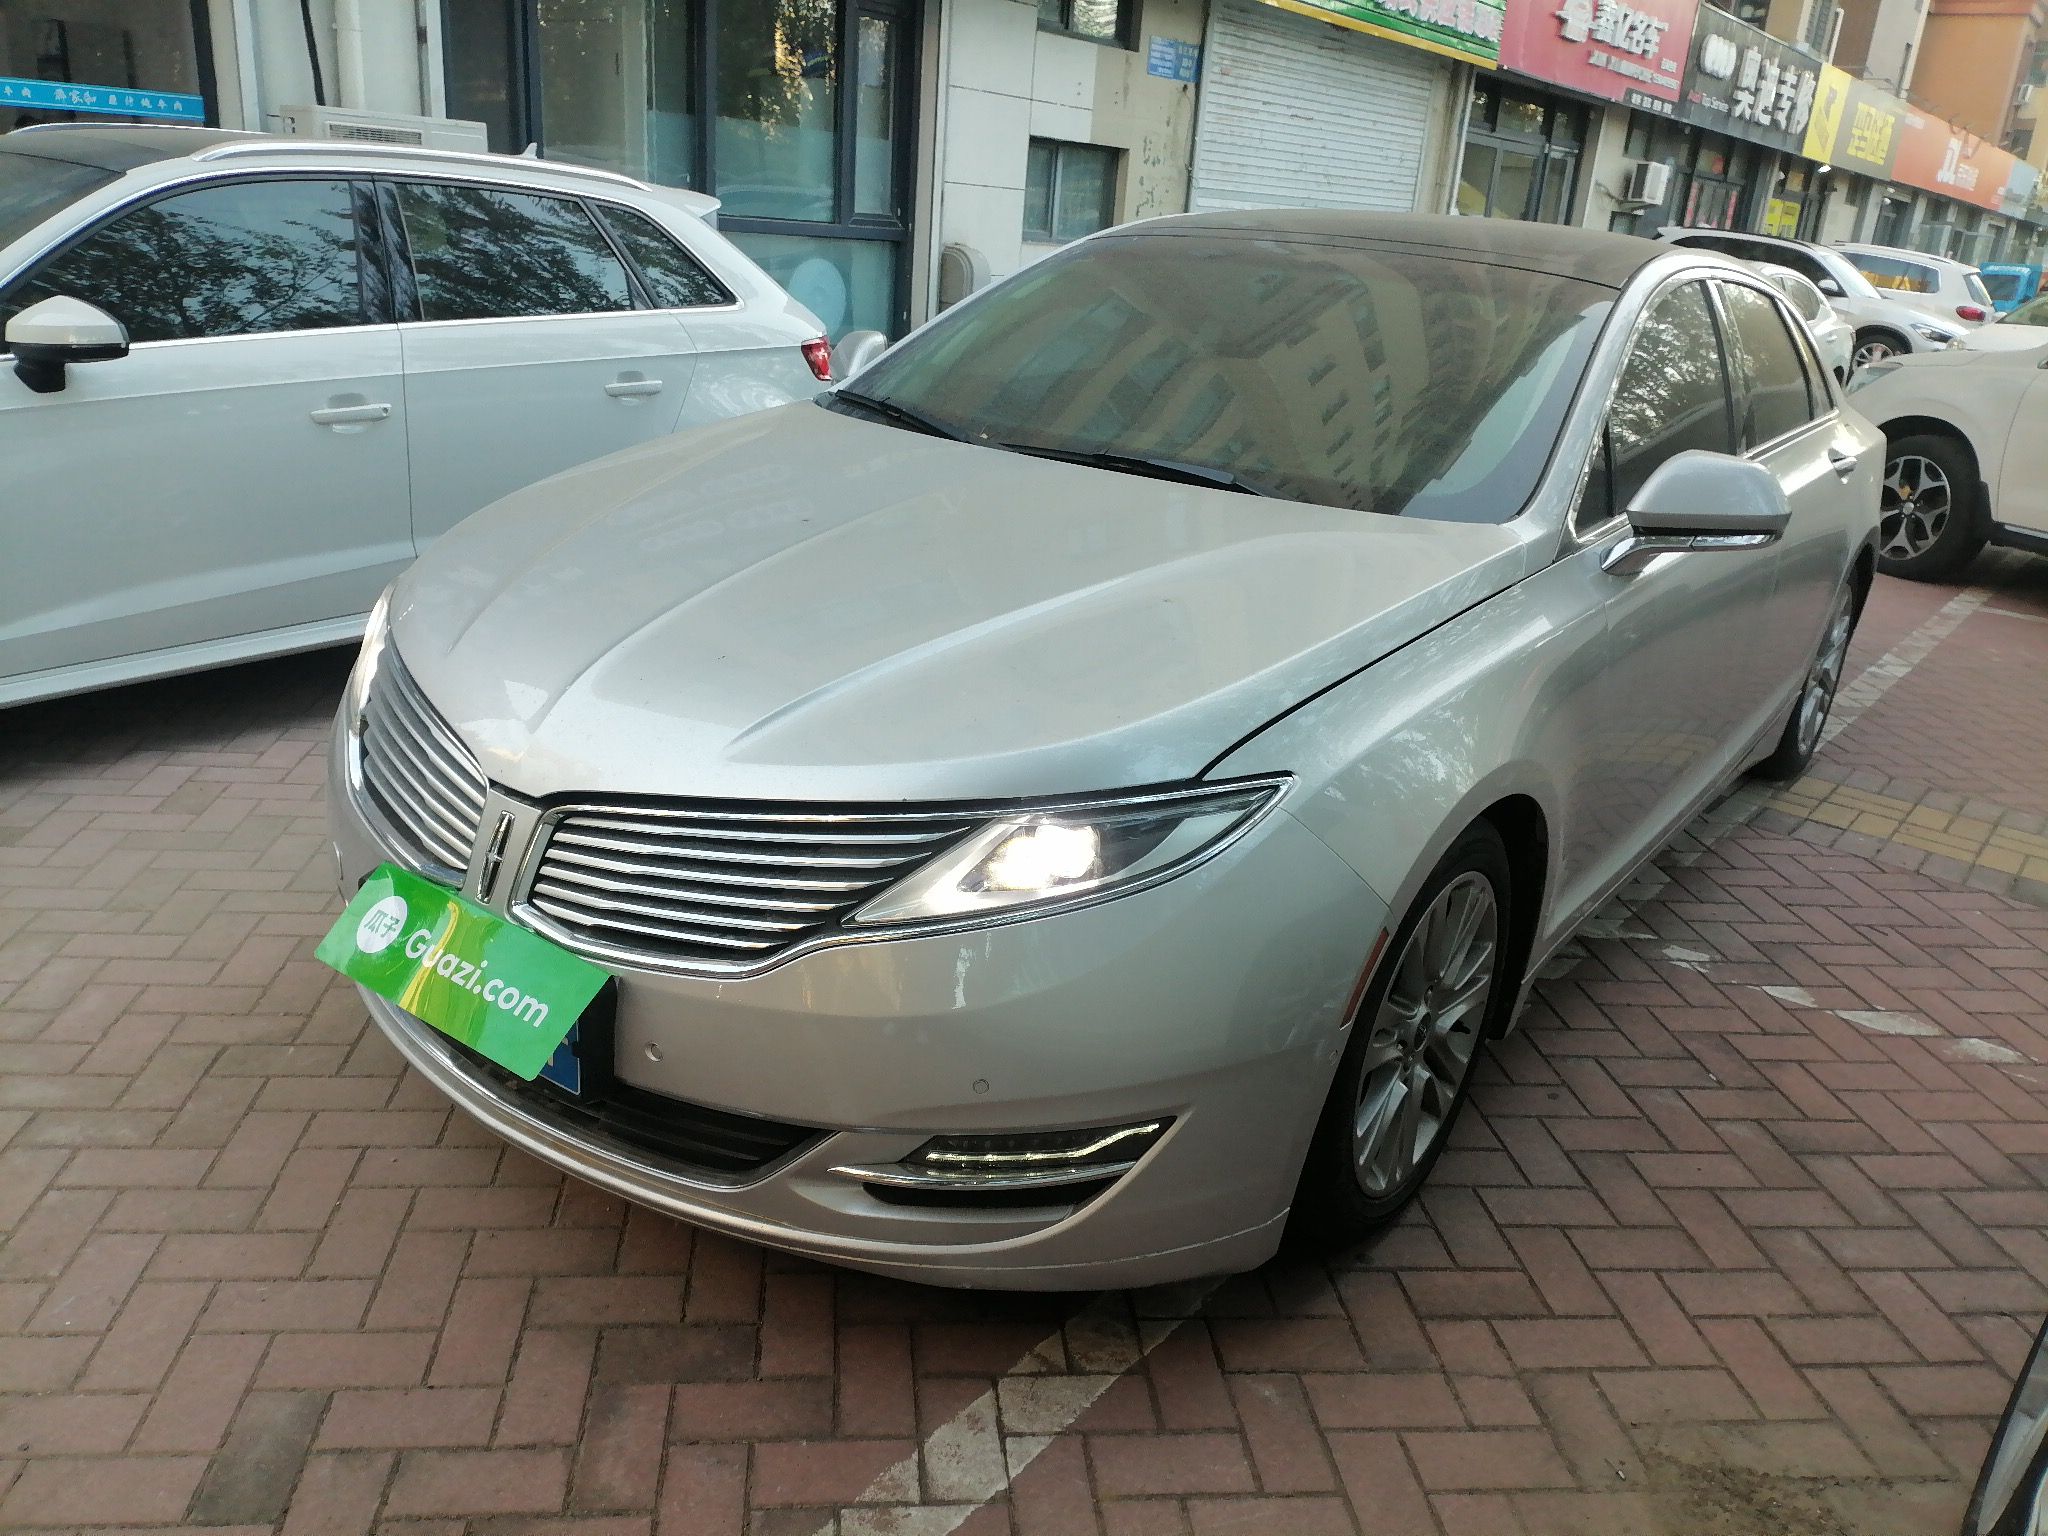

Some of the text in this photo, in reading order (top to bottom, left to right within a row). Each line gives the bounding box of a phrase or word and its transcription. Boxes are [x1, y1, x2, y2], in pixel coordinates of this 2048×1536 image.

[1734, 45, 1817, 135] 奥迪专修
[364, 909, 400, 938] 瓜子
[405, 928, 549, 1027] Guazi.com
